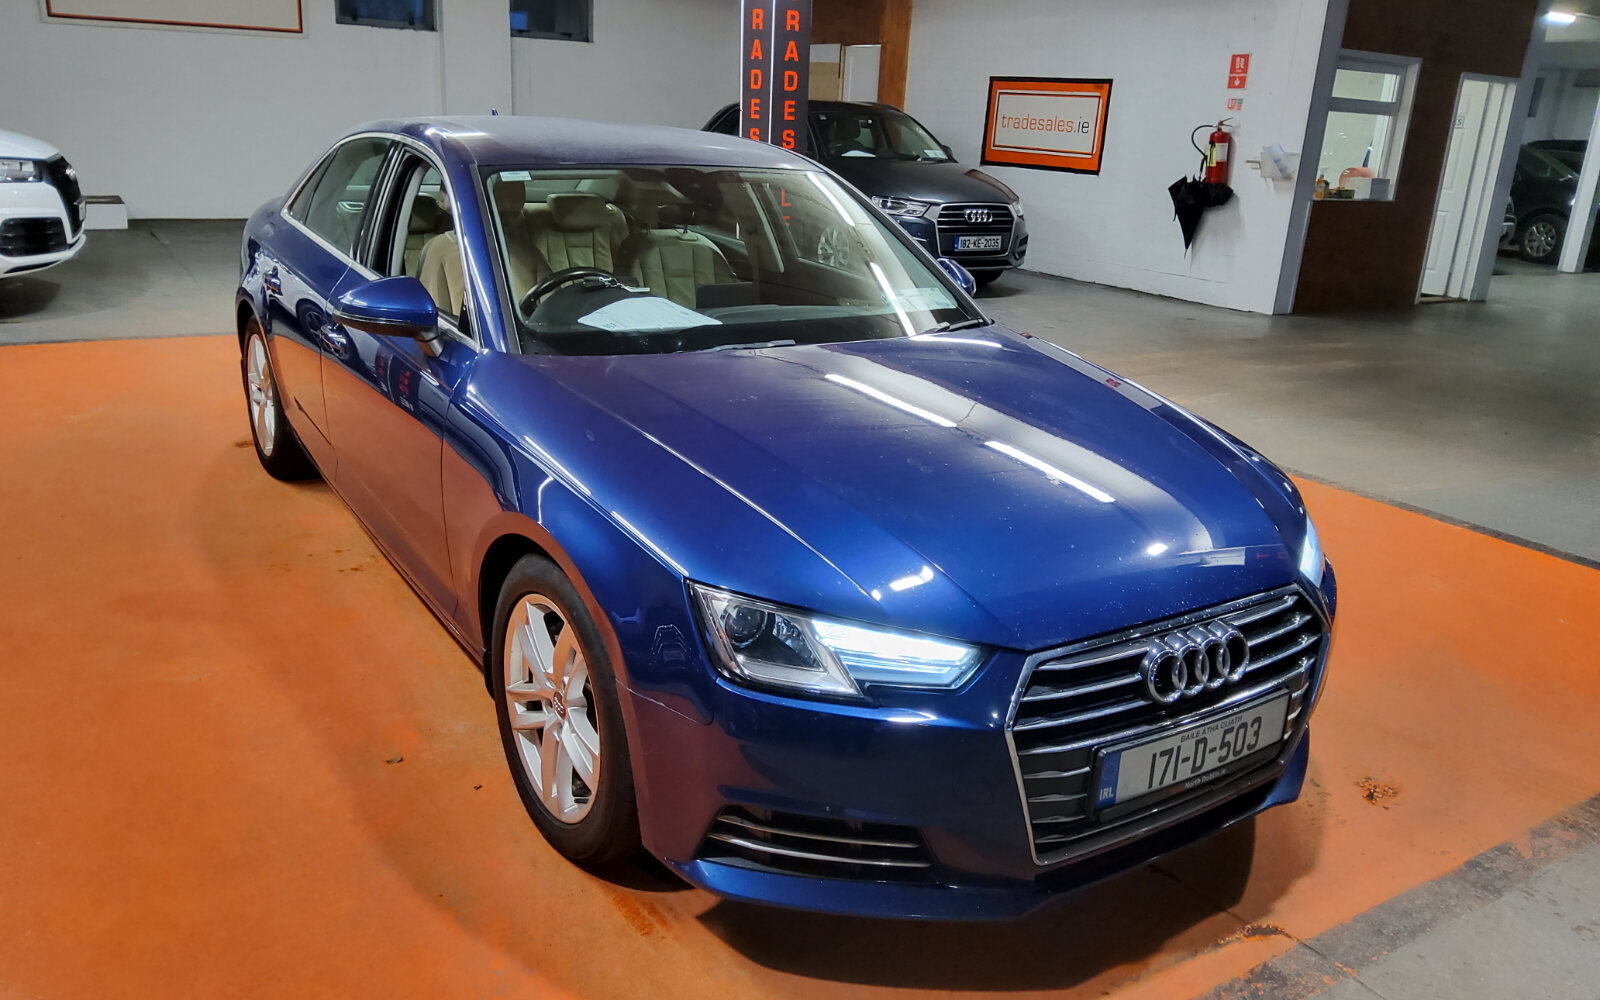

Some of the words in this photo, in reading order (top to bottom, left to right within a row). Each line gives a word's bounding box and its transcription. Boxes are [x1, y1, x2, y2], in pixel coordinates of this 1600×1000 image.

[782, 0, 800, 150] RADES
[1001, 113, 1090, 134] tradesales.ie
[960, 238, 1000, 249] 182-KE-2035
[1180, 733, 1200, 743] BAILE
[1220, 715, 1243, 731] CLIATH
[1148, 716, 1263, 789] 171-D-503
[1100, 786, 1115, 801] IRL
